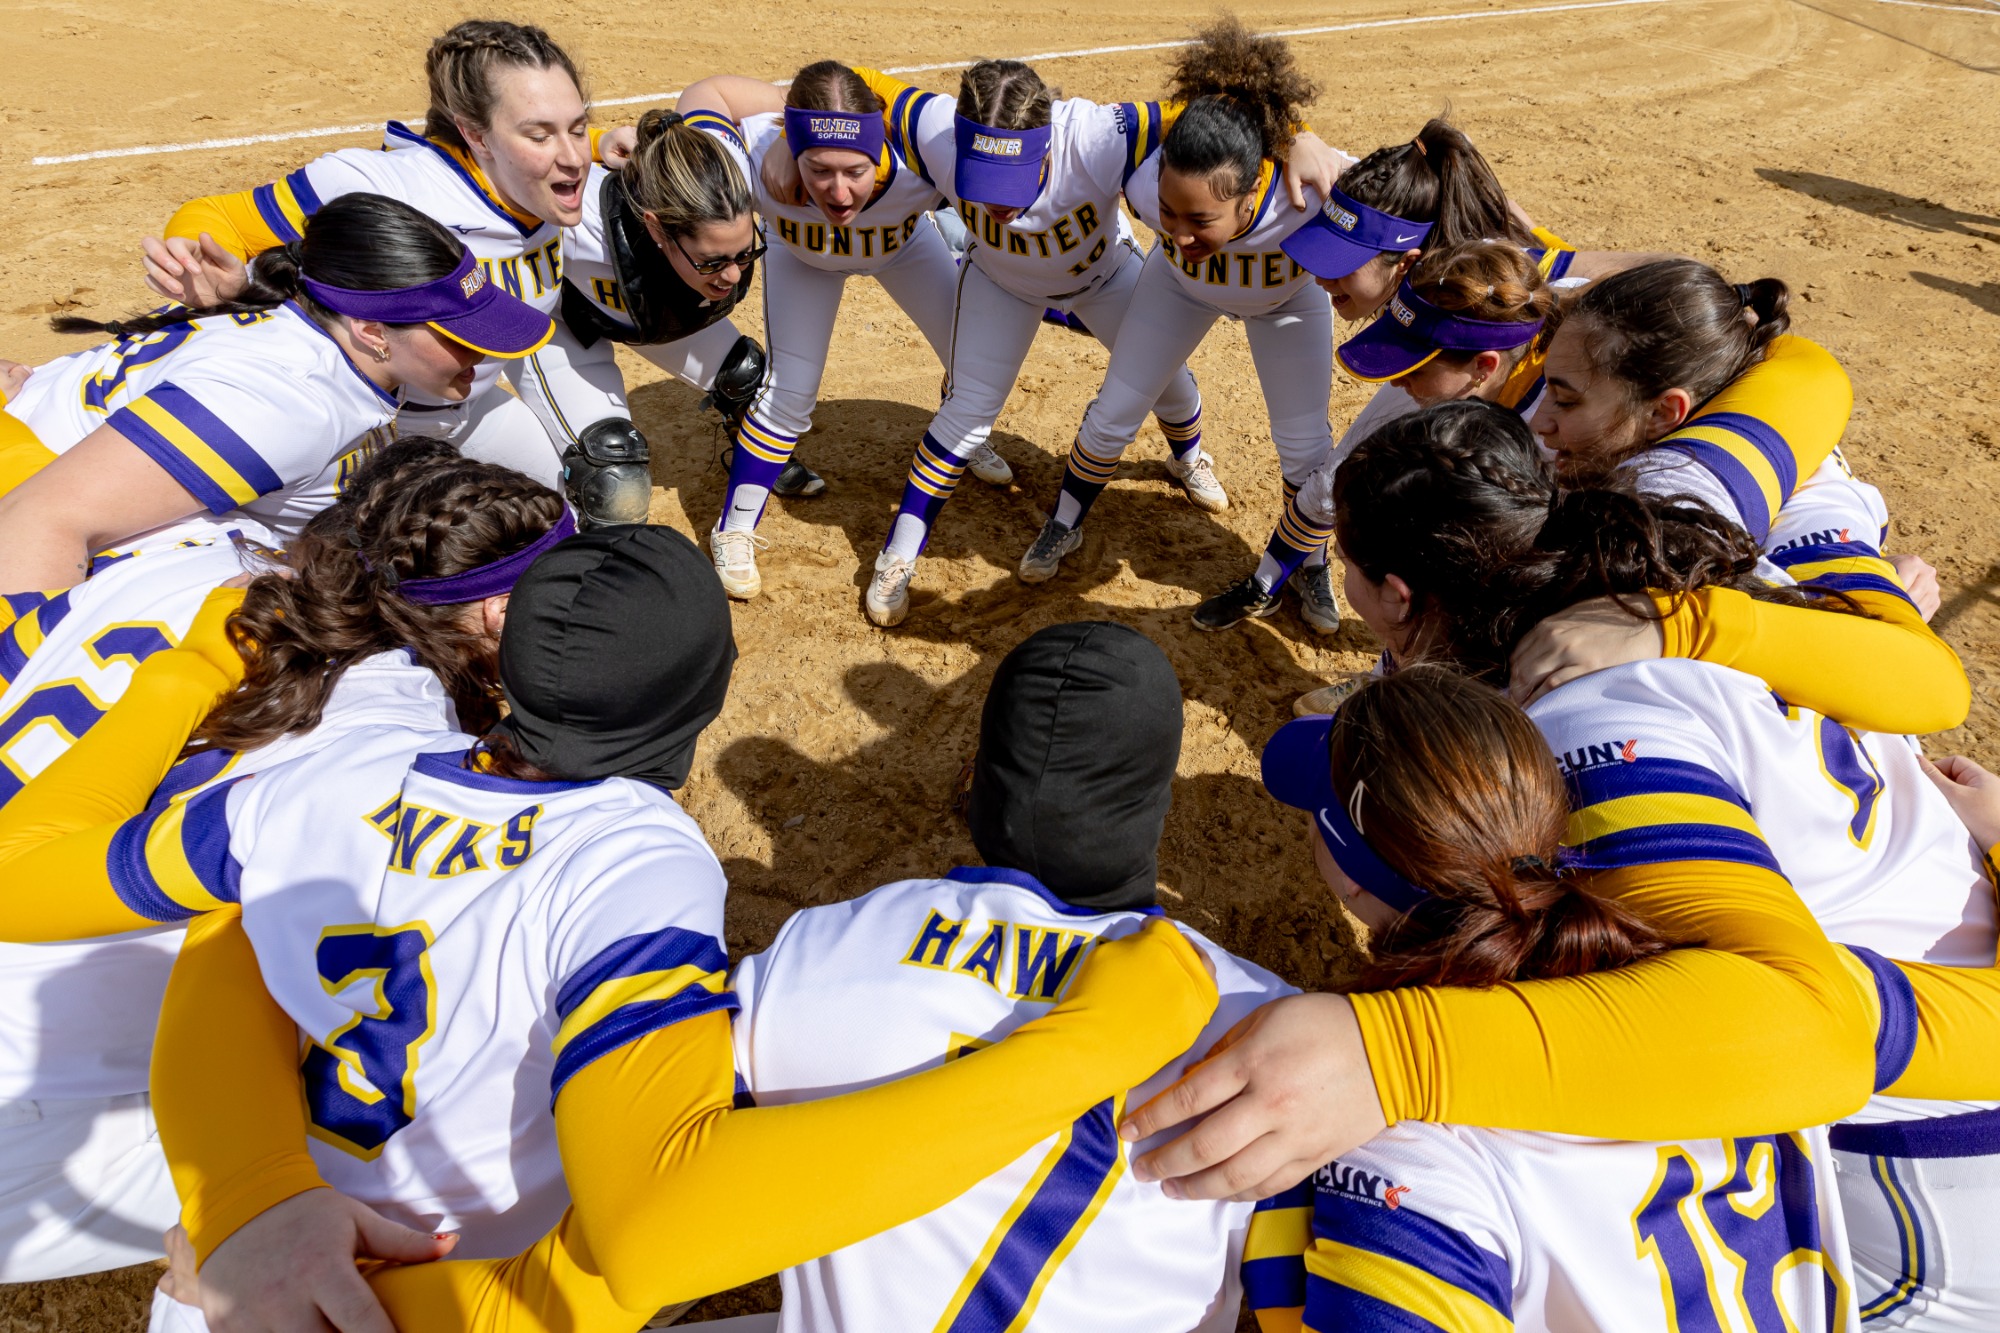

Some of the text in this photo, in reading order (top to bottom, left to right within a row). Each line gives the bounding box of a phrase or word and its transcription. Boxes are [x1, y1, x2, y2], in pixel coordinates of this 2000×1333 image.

[810, 118, 860, 133] HUNTER
[1112, 104, 1127, 135] CUN
[818, 132, 856, 140] SOFTBALL
[972, 133, 1022, 156] HUNTER
[958, 198, 1101, 258] HUNTER
[1067, 235, 1109, 277] 10
[899, 907, 1108, 1004] HAW
